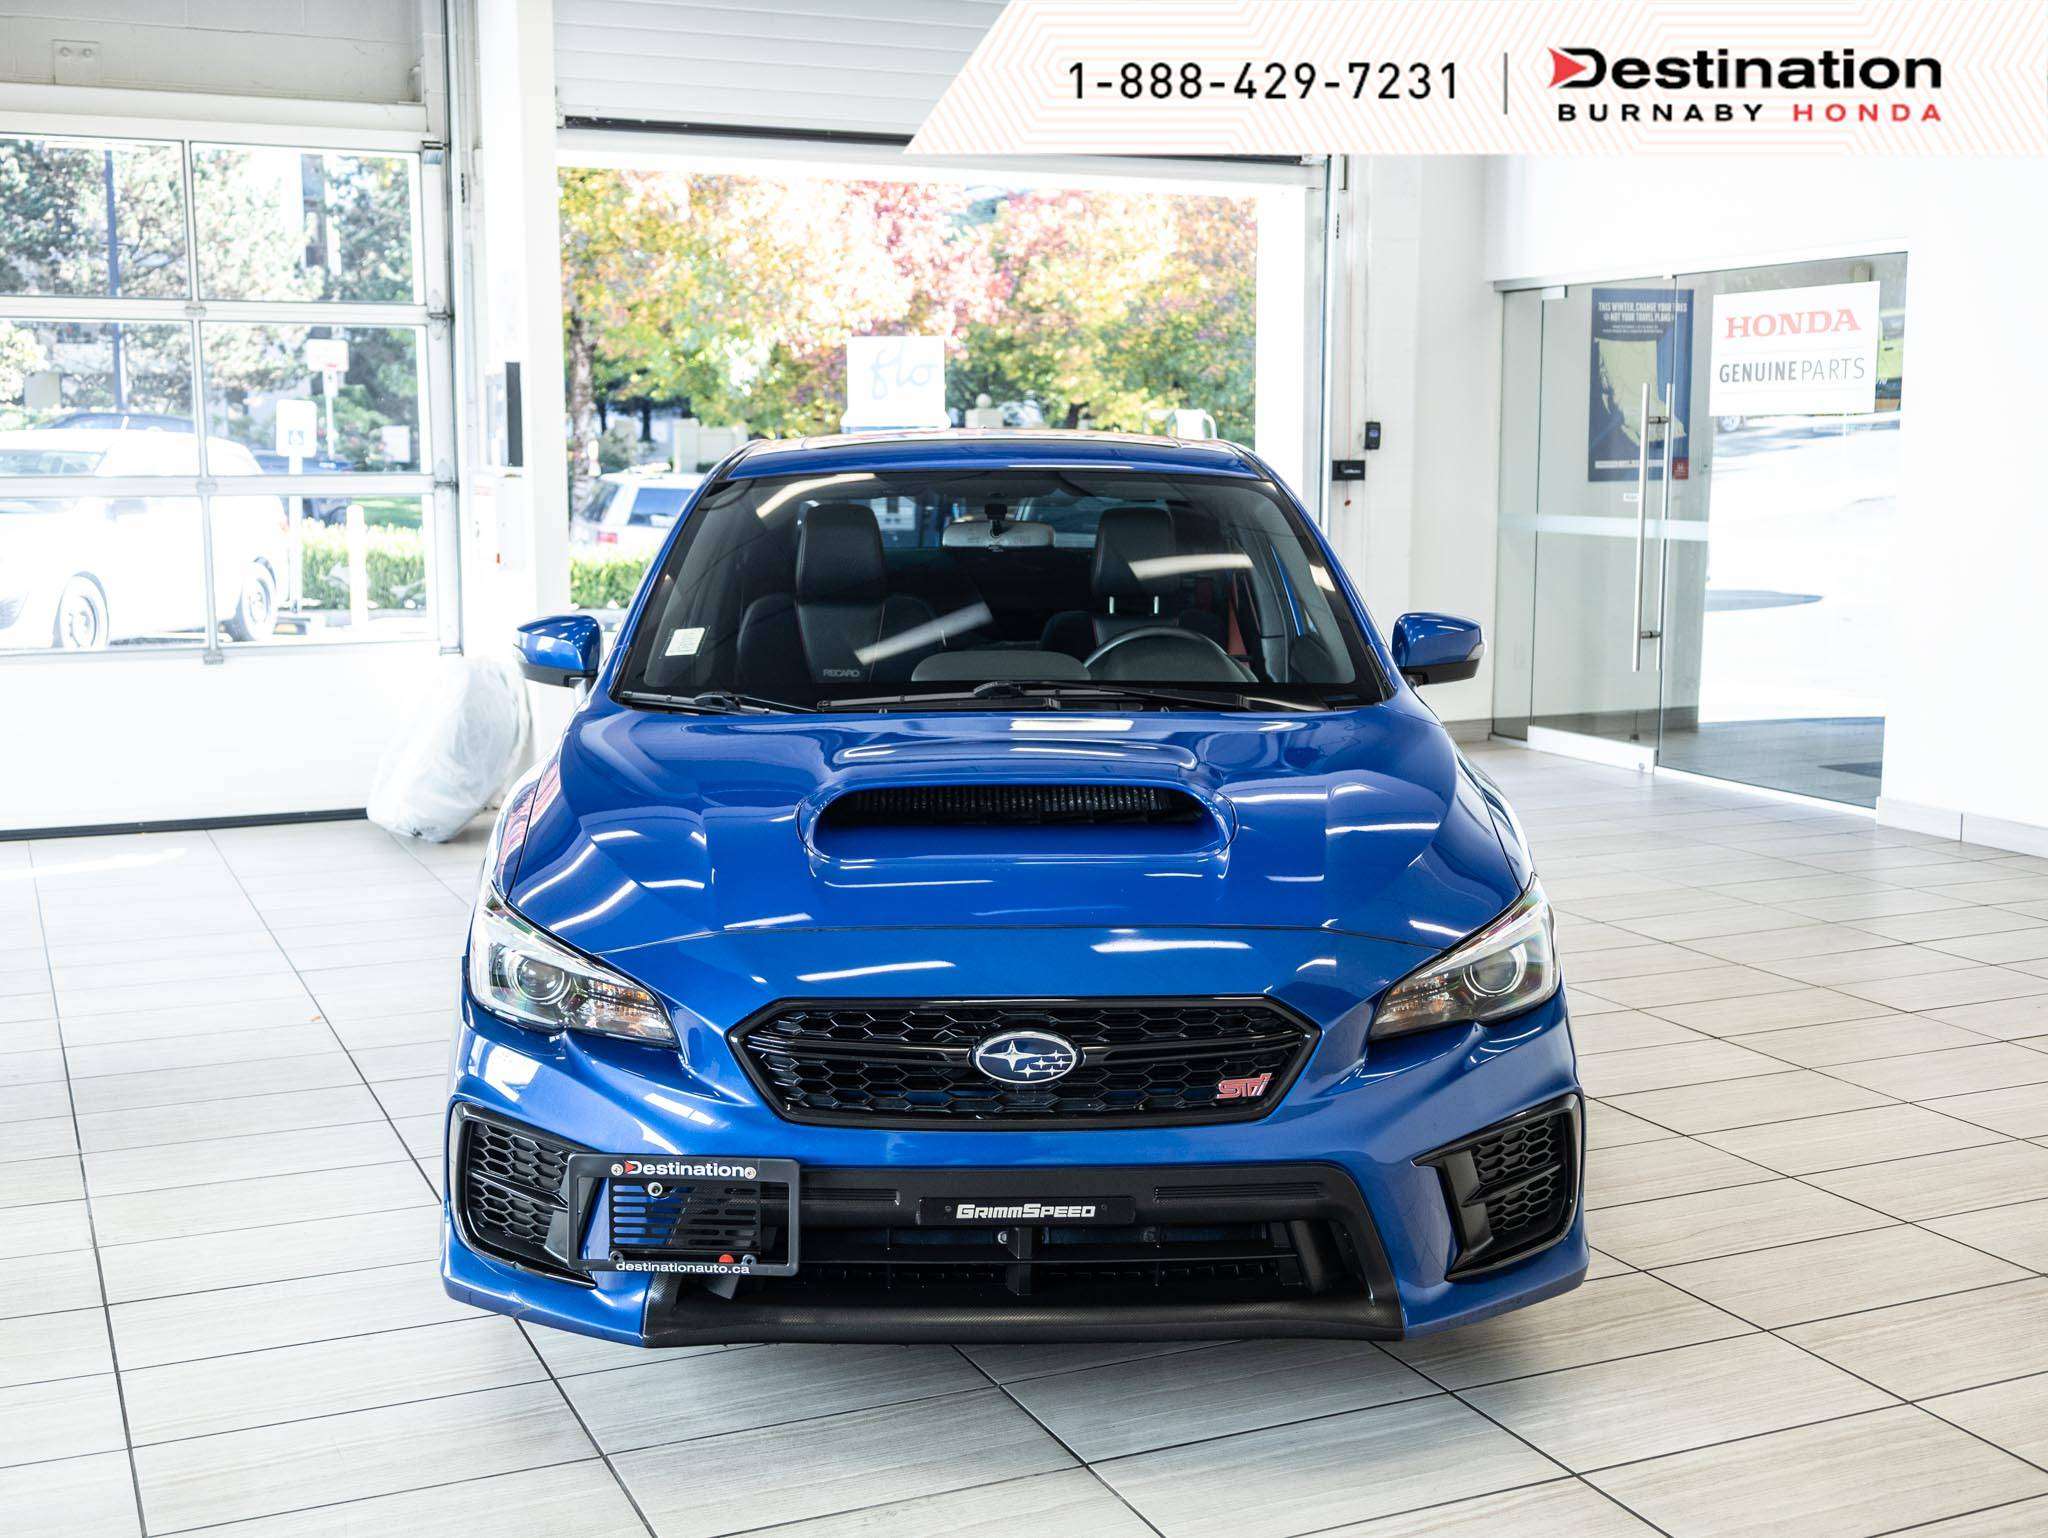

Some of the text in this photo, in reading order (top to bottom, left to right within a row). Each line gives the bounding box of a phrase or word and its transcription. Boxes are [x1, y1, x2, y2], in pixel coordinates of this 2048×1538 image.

[1725, 308, 1862, 339] HONDA
[1719, 357, 1865, 383] GENUINE PARTS
[823, 668, 861, 678] RECARO
[624, 1160, 745, 1178] Destination
[615, 1261, 750, 1275] destinationauto.ca
